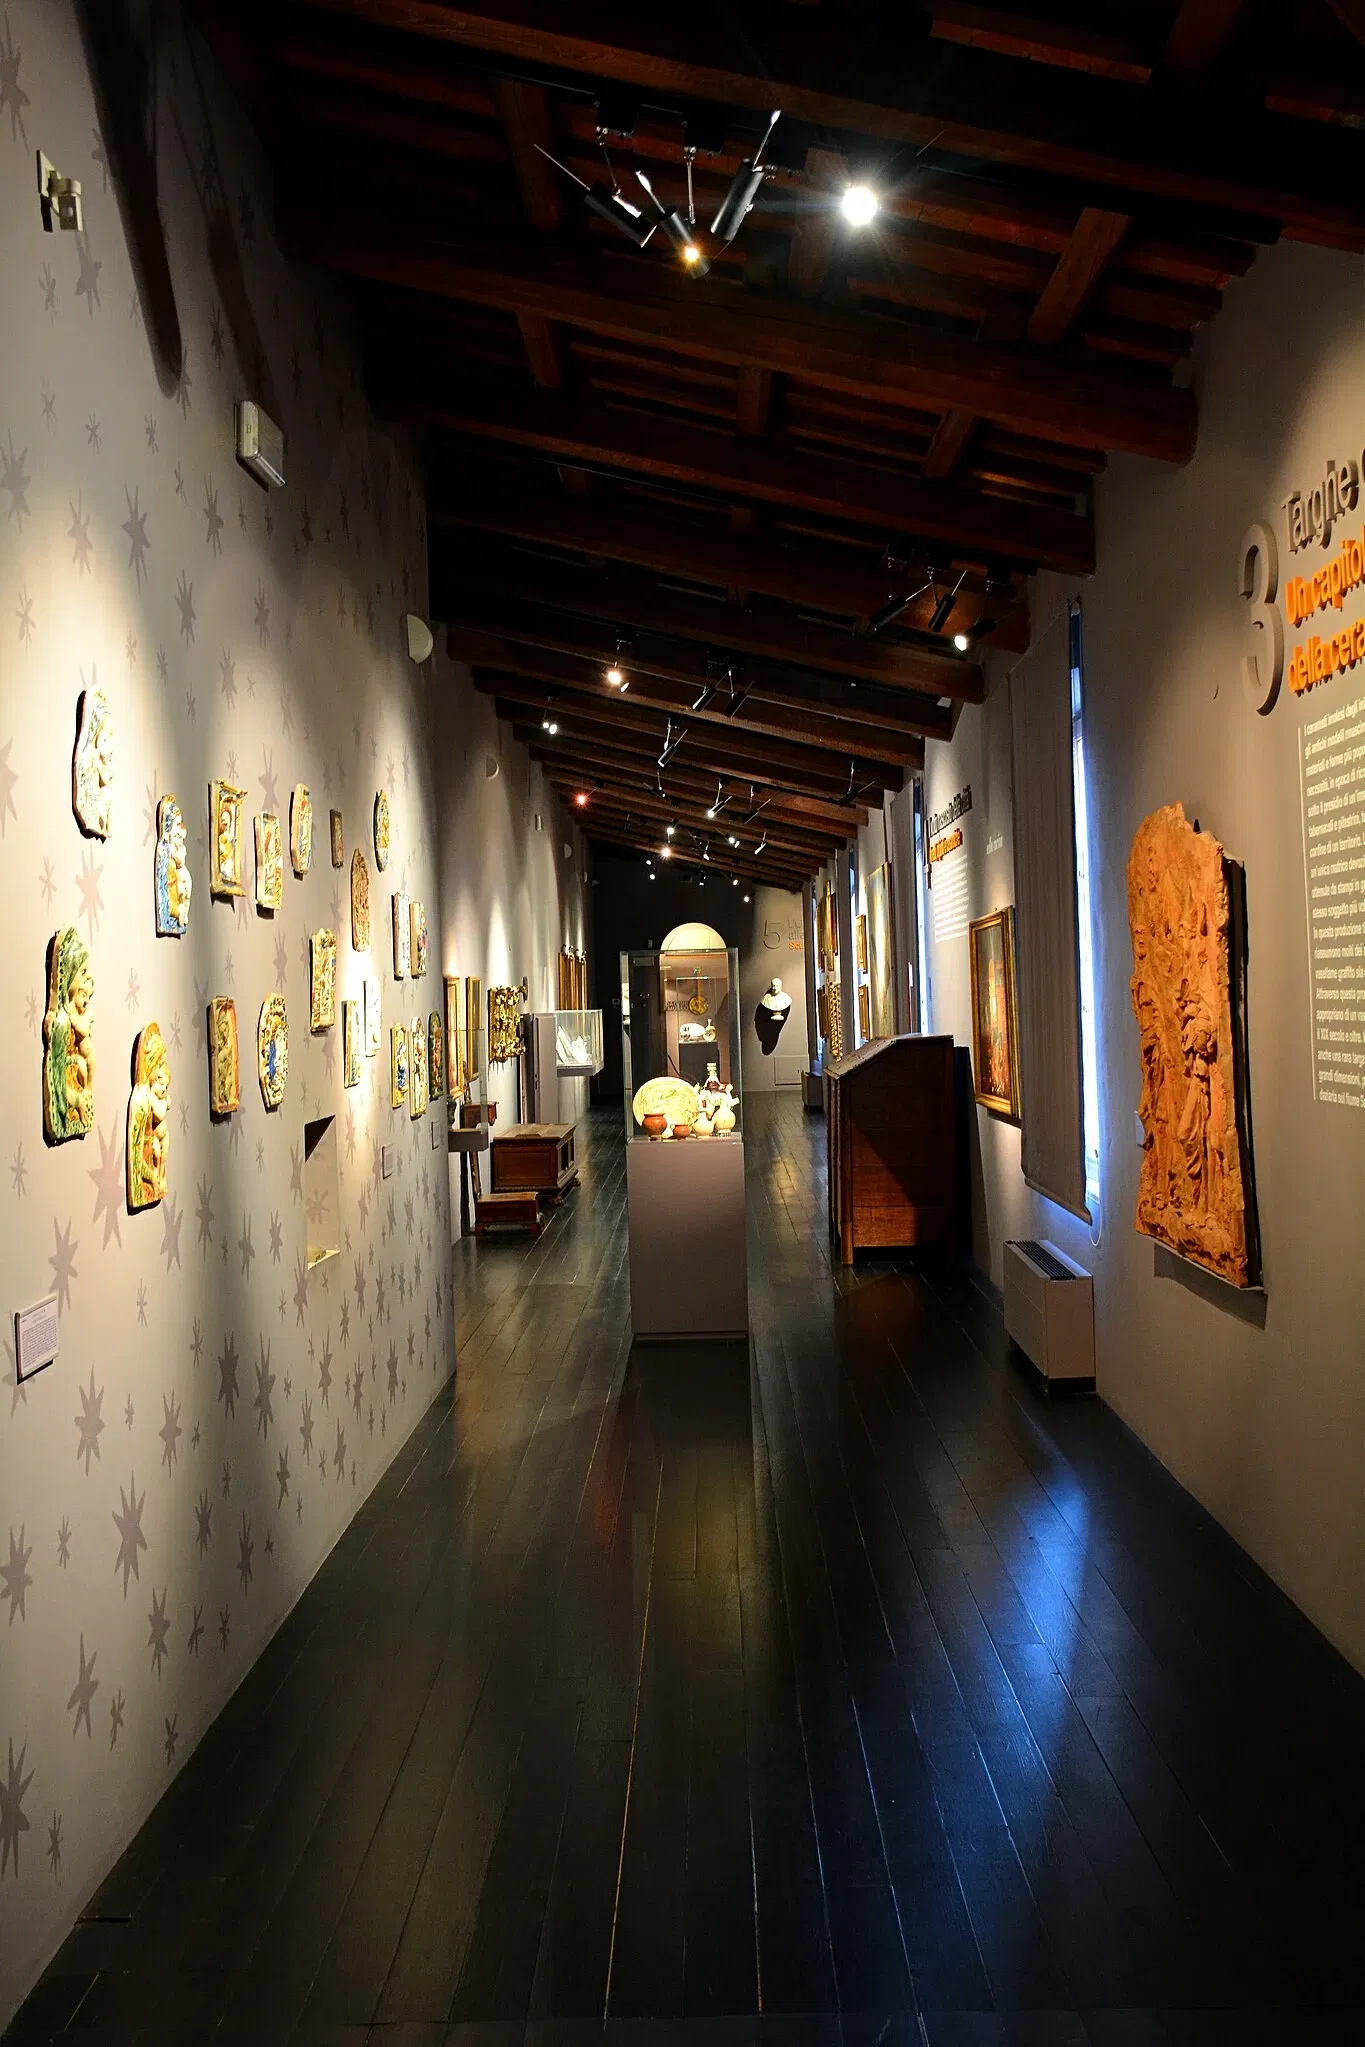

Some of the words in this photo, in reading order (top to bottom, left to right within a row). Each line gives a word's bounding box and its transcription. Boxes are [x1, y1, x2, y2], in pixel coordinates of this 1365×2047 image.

[1280, 460, 1359, 552] Targhe
[1285, 577, 1314, 627] Un
[1238, 520, 1284, 716] 3
[1287, 637, 1330, 695] della
[1335, 773, 1350, 790] epoca
[1323, 796, 1343, 815] presidio
[1343, 792, 1349, 806] di
[1308, 819, 1334, 838] tabernacoli
[1309, 843, 1326, 858] confine
[1337, 879, 1354, 896] stampi
[1312, 907, 1327, 919] stesso
[1327, 903, 1349, 919] soggetto
[1349, 900, 1358, 917] più
[763, 919, 783, 950] 5
[1318, 926, 1334, 942] questa
[1334, 923, 1362, 940] produzione
[1315, 987, 1339, 1000] Attraverso
[1316, 1008, 1344, 1023] appropriano
[1344, 1008, 1350, 1021] di
[1329, 1029, 1345, 1042] secolo
[1317, 1049, 1332, 1061] anche
[1332, 1052, 1342, 1062] una
[1318, 1069, 1333, 1083] grandi
